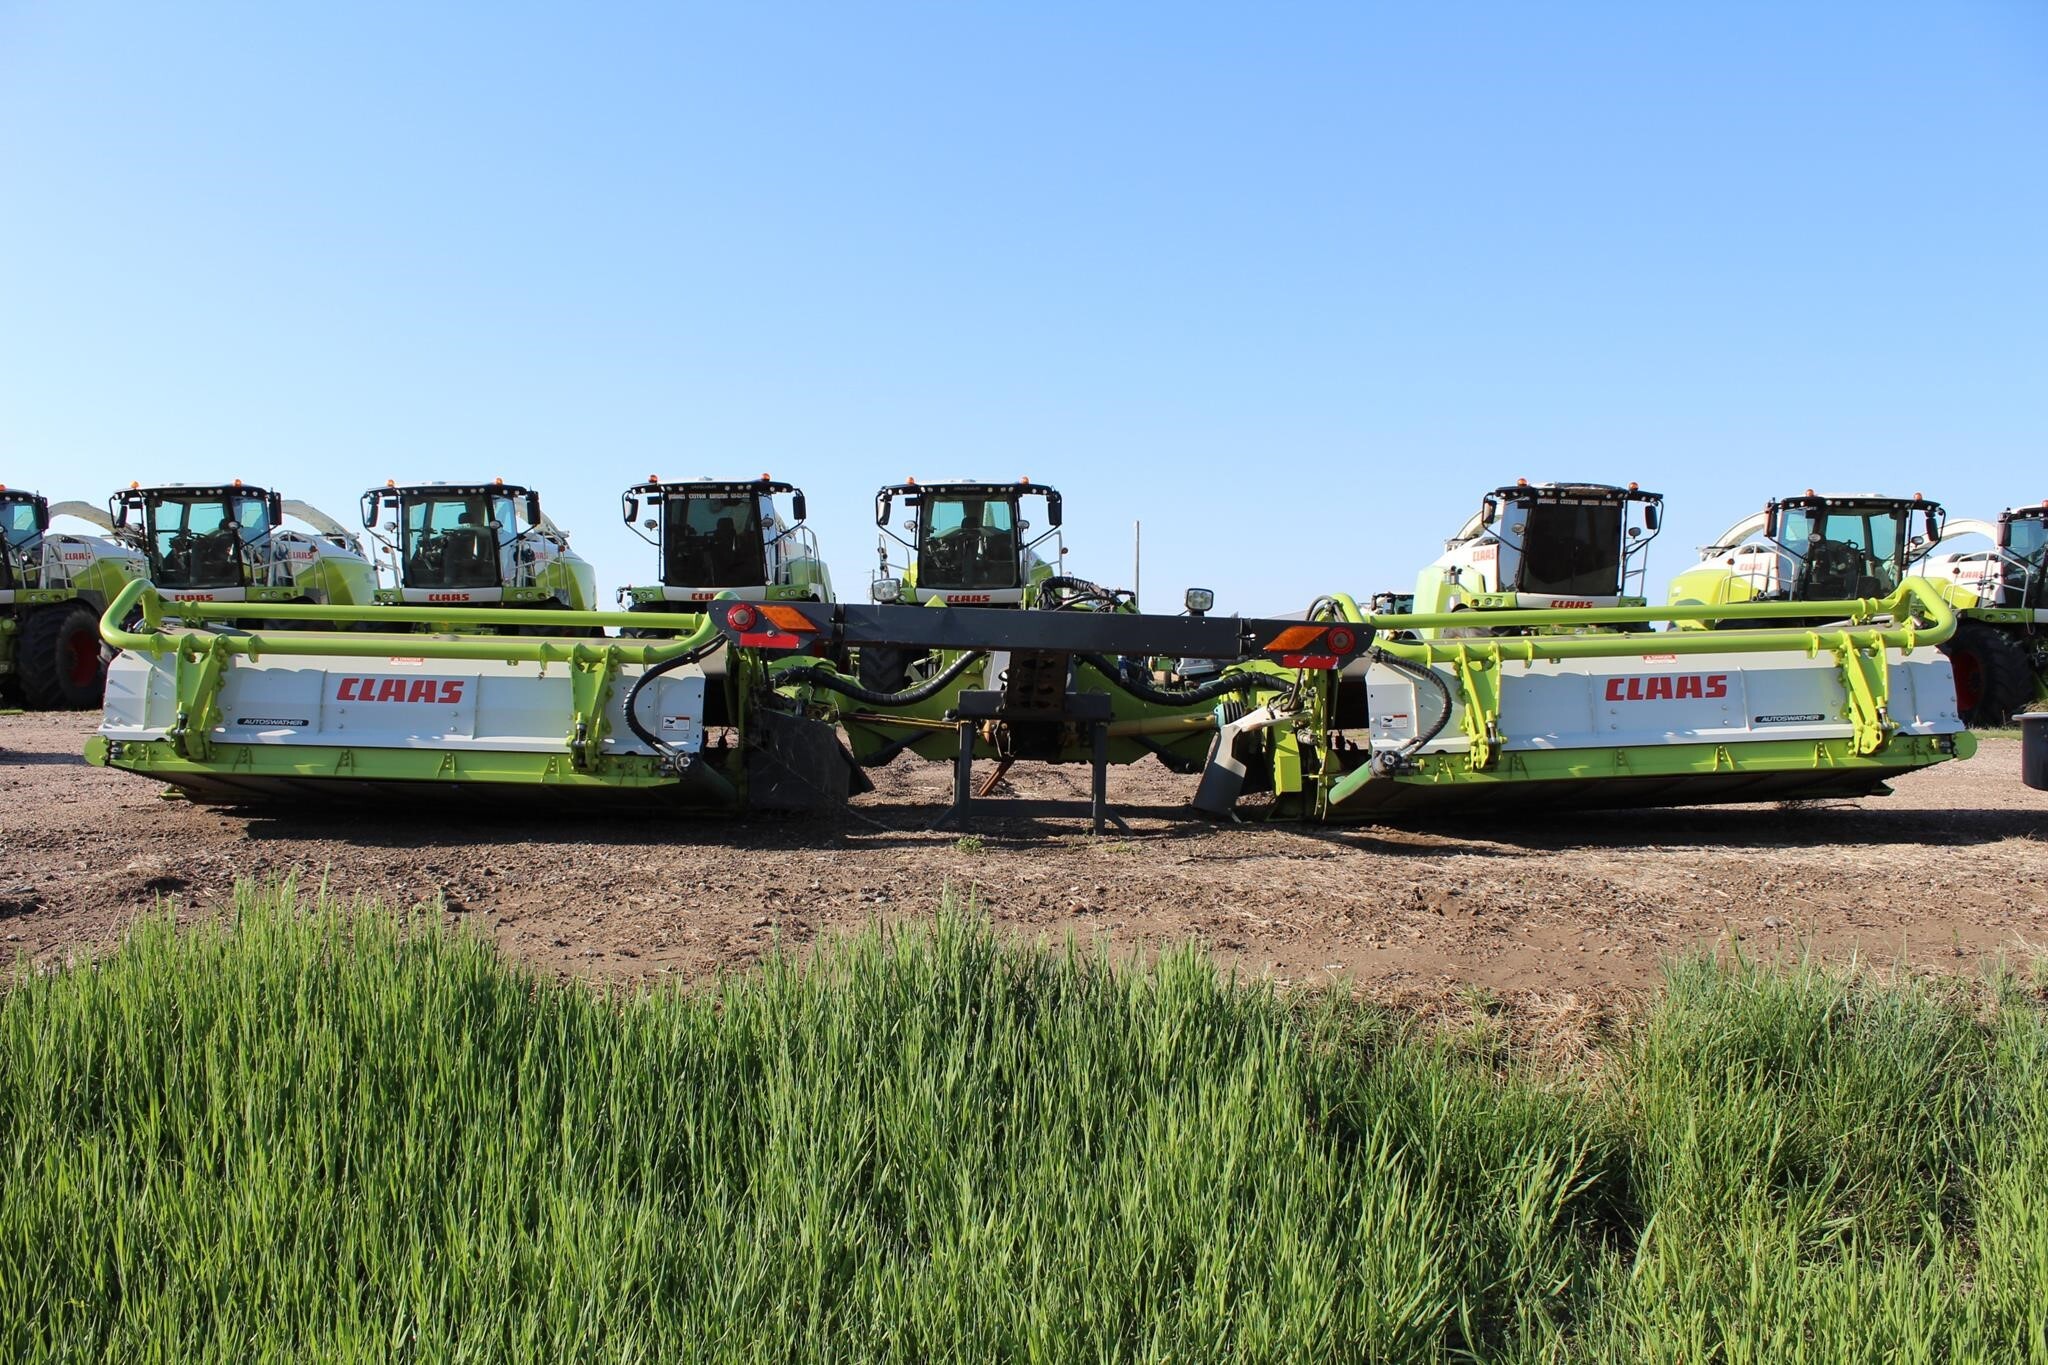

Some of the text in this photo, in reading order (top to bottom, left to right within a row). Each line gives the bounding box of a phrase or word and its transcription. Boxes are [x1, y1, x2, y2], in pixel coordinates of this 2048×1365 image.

[429, 593, 469, 601] CLAAS
[1551, 600, 1592, 608] CLAAS
[336, 678, 465, 704] CLAAS
[1605, 675, 1727, 701] CLAAS
